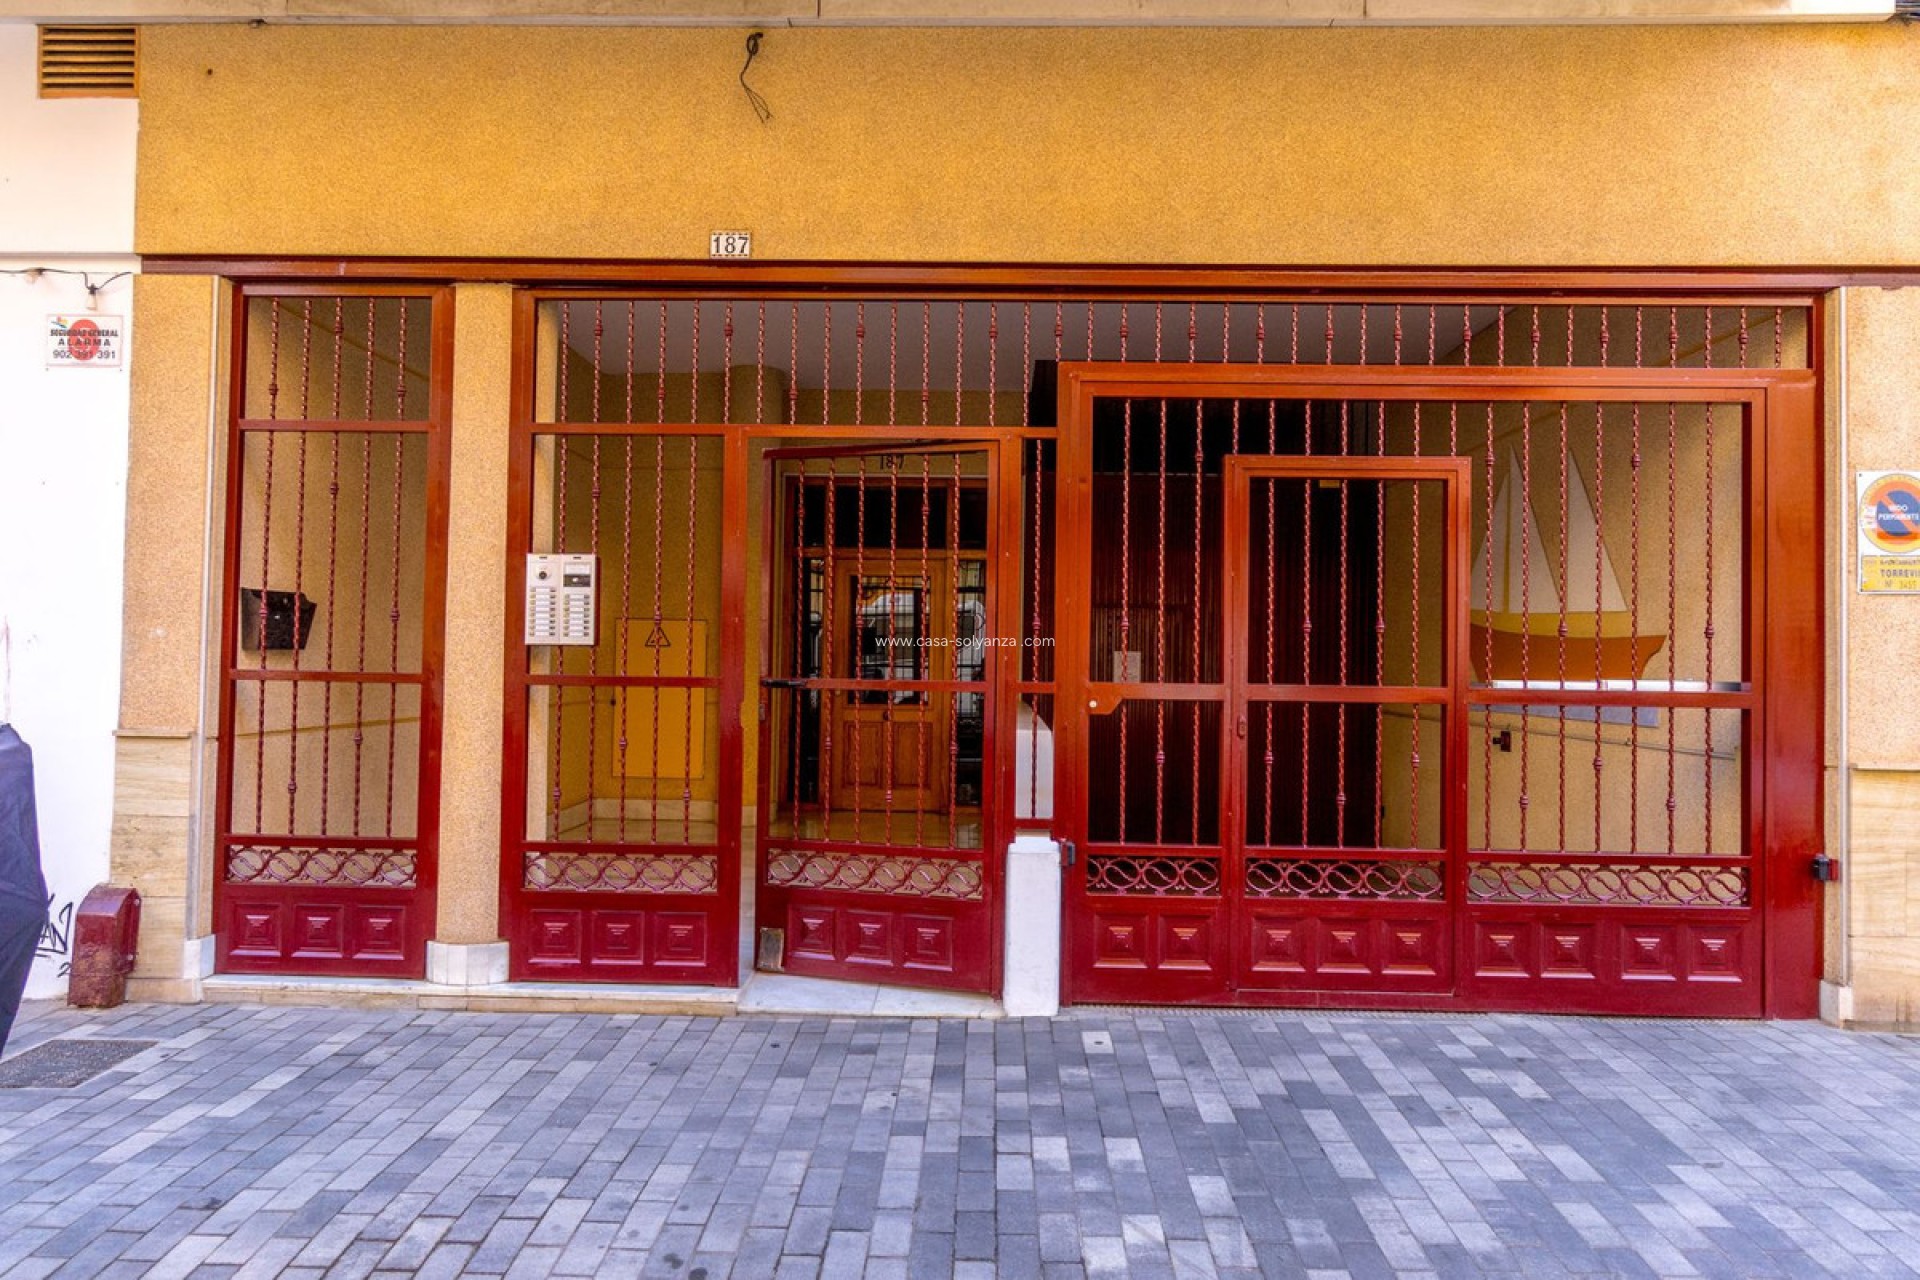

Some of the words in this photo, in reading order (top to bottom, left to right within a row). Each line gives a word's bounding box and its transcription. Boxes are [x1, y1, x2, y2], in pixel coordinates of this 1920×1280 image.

[713, 236, 749, 254] 187
[87, 329, 119, 337] GENERAL
[52, 350, 72, 359] 902
[97, 350, 116, 359] 391
